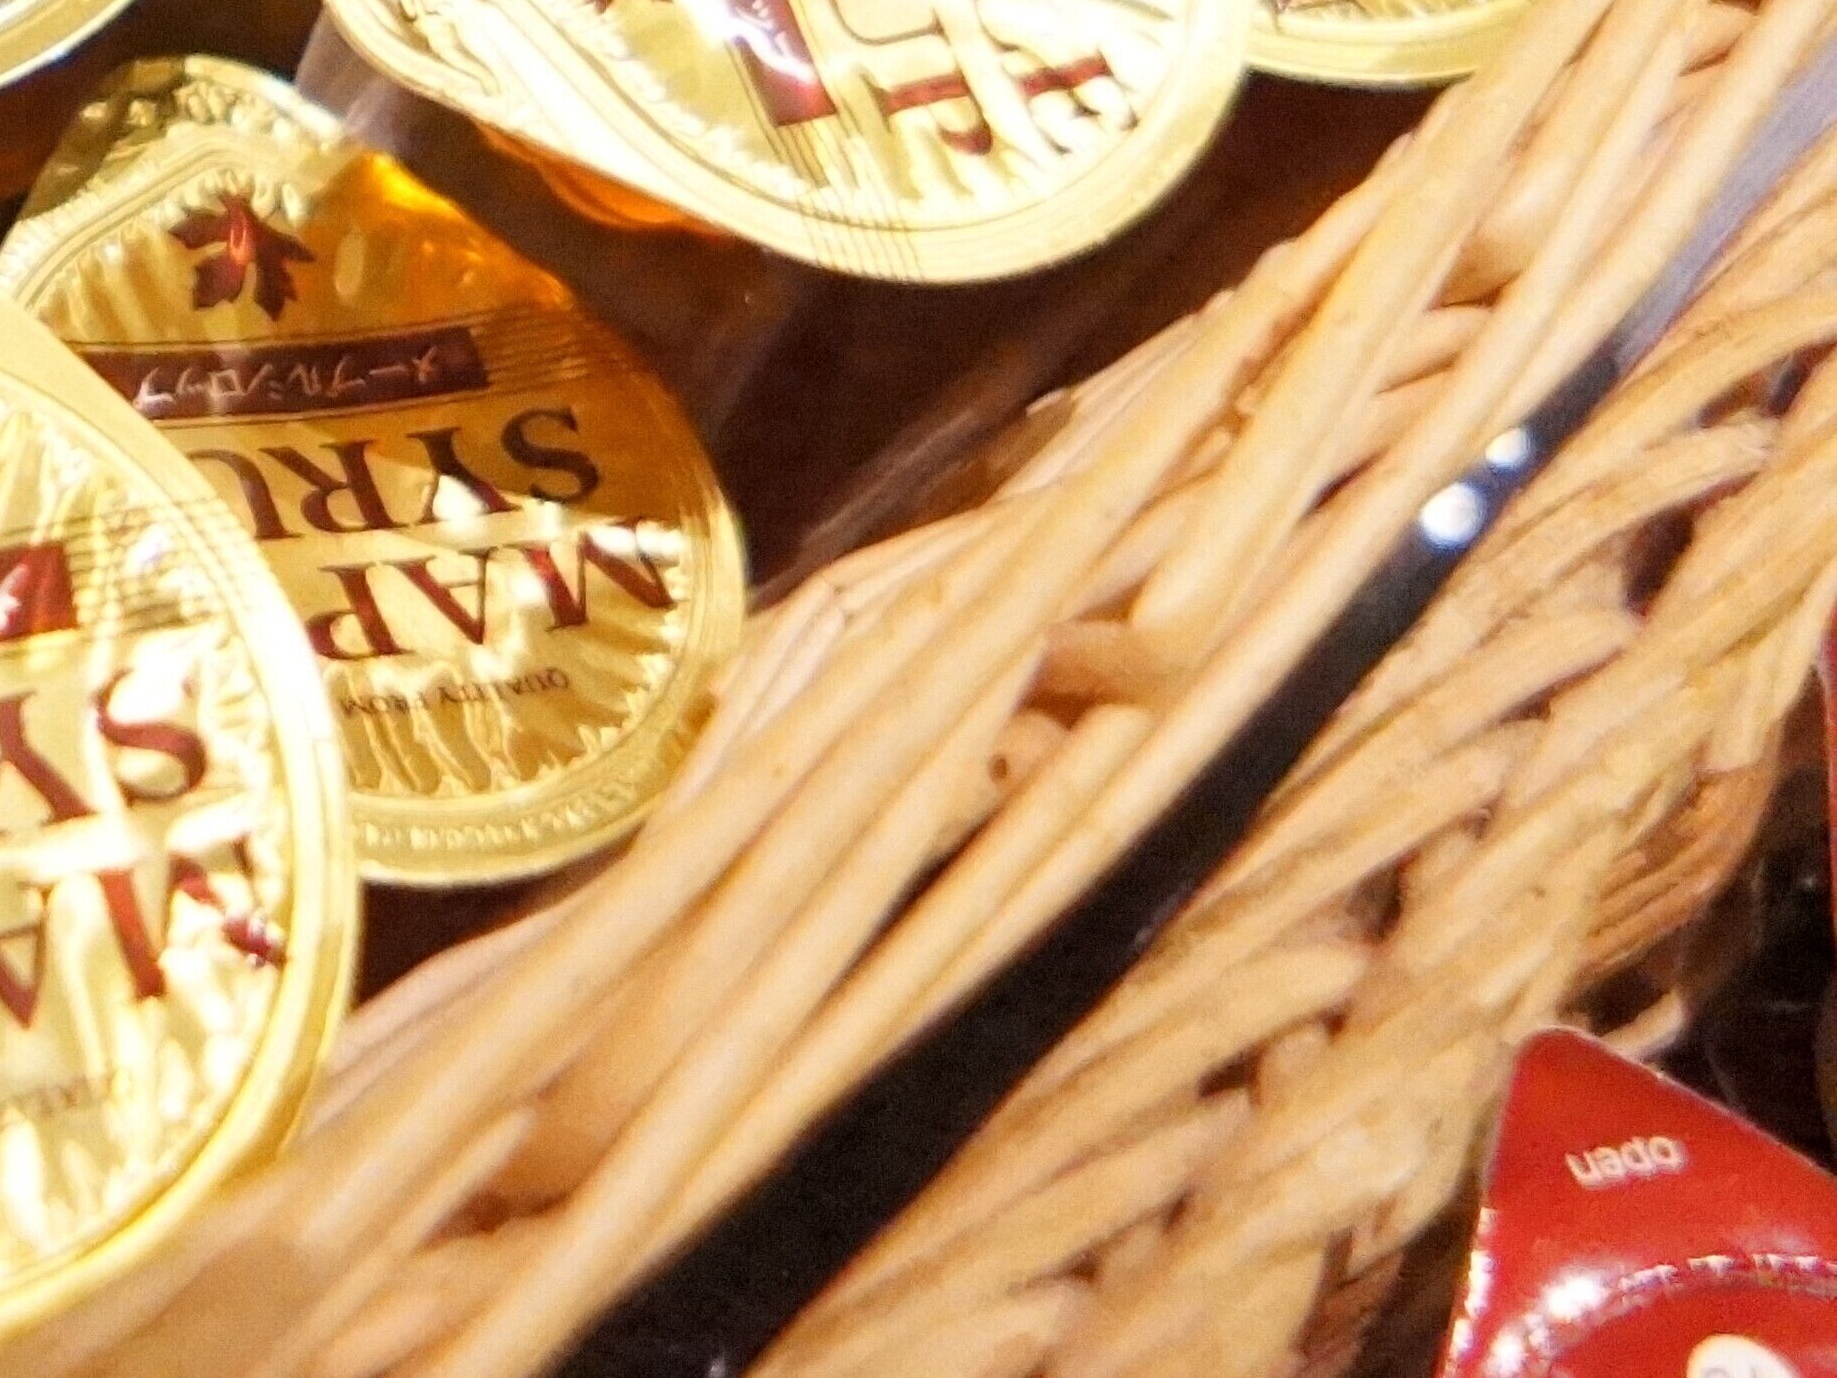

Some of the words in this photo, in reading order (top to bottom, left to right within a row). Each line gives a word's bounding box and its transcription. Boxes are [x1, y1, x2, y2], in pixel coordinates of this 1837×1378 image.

[133, 348, 445, 414] メープルシロップ
[186, 404, 601, 540] SYRU
[308, 516, 683, 663] MAP
[1565, 1135, 1686, 1190] open
